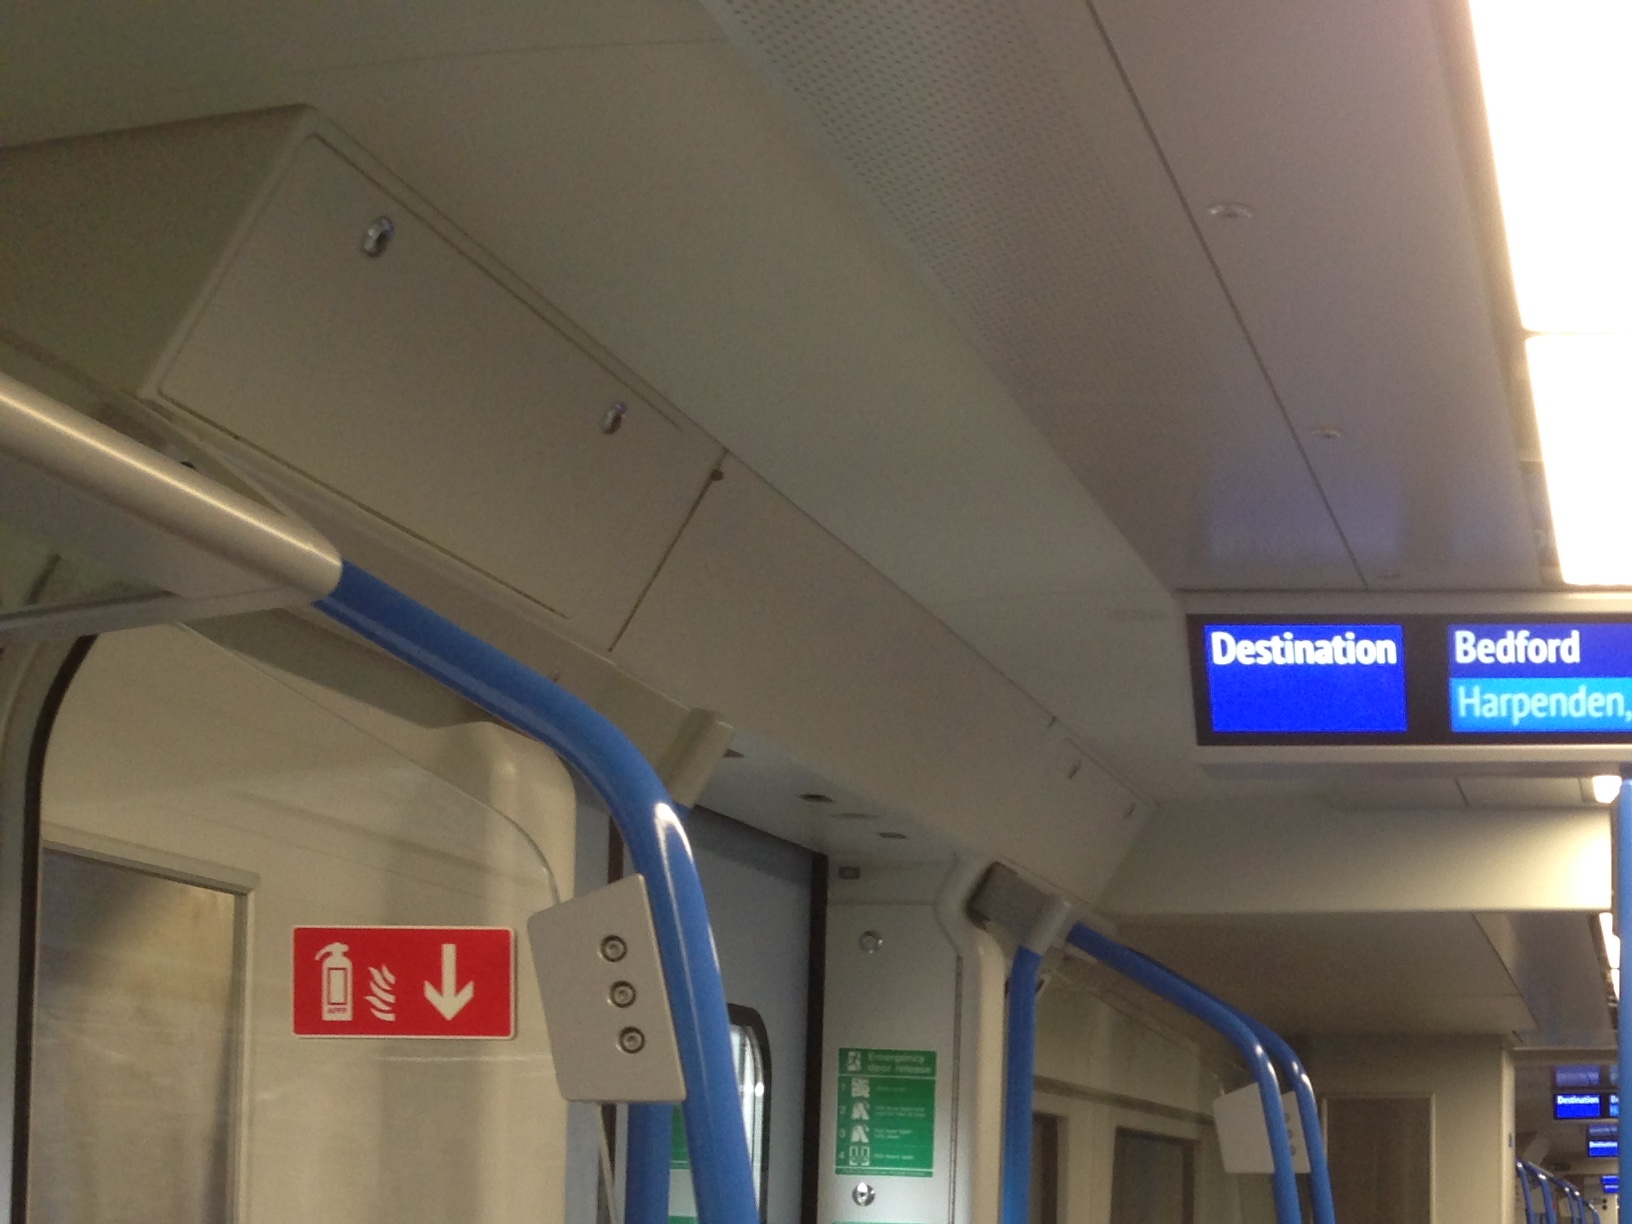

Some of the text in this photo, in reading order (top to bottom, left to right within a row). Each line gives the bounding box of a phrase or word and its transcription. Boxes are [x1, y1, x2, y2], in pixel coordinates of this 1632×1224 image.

[1210, 631, 1398, 665] Destination
[1454, 629, 1582, 664] Bedford
[1557, 1095, 1600, 1105] Destination
